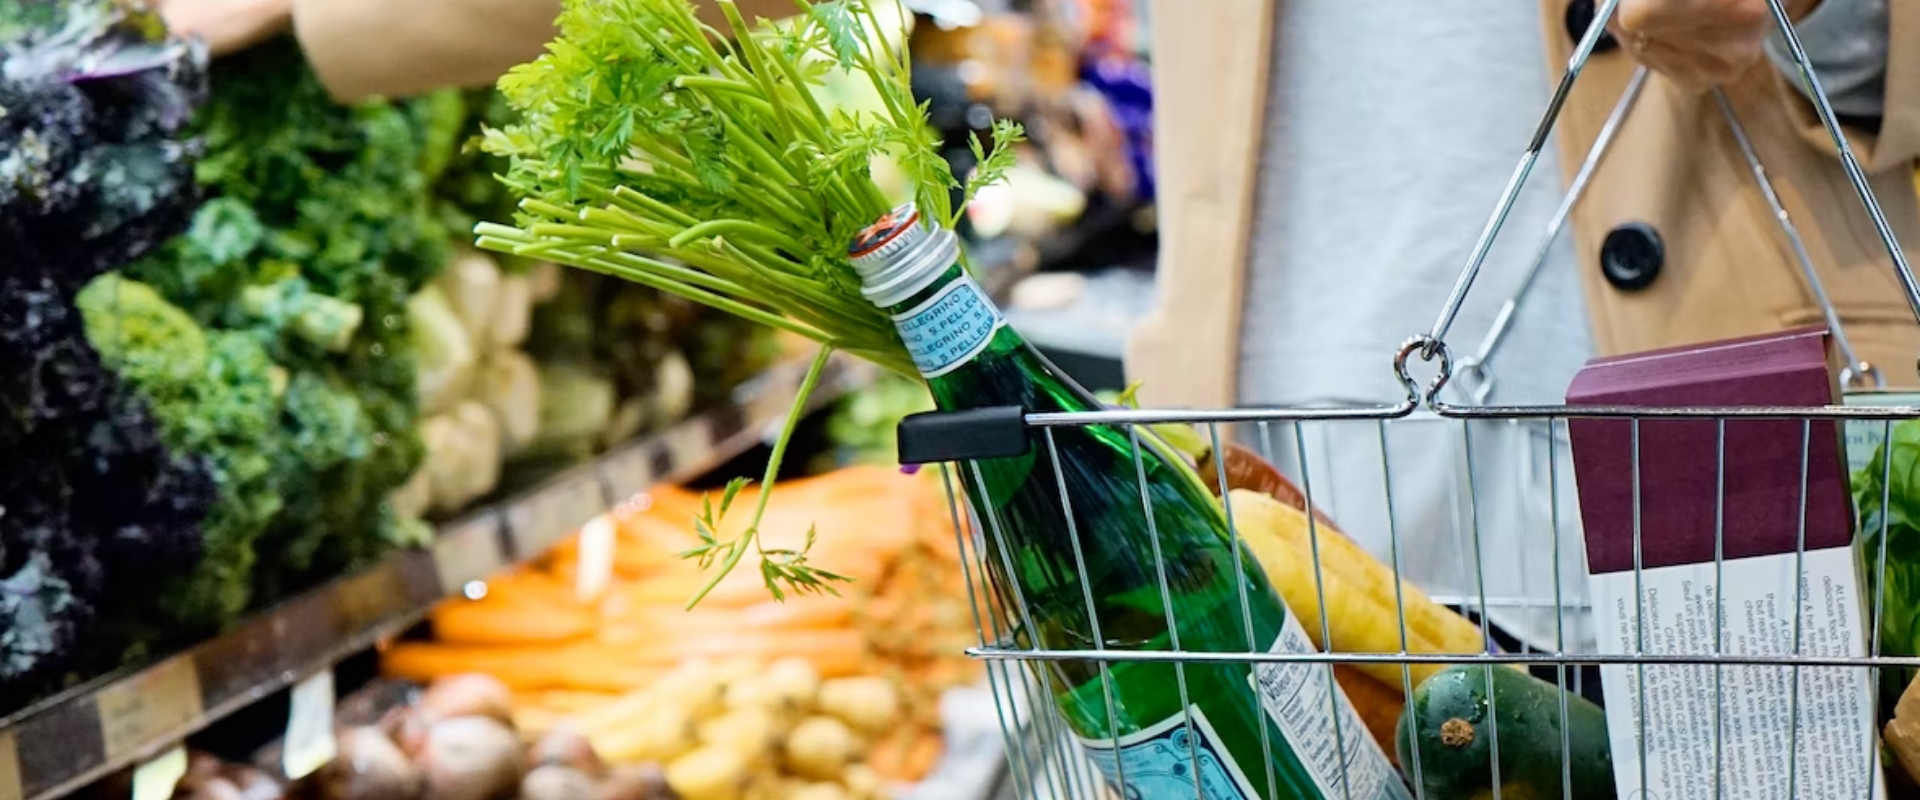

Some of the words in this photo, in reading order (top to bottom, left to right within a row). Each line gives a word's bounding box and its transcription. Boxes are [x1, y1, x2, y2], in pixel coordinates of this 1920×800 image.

[1745, 599, 1757, 635] cheese
[1723, 631, 1733, 655] Stow
[1823, 575, 1836, 617] delicious
[1836, 676, 1849, 716] fabulous
